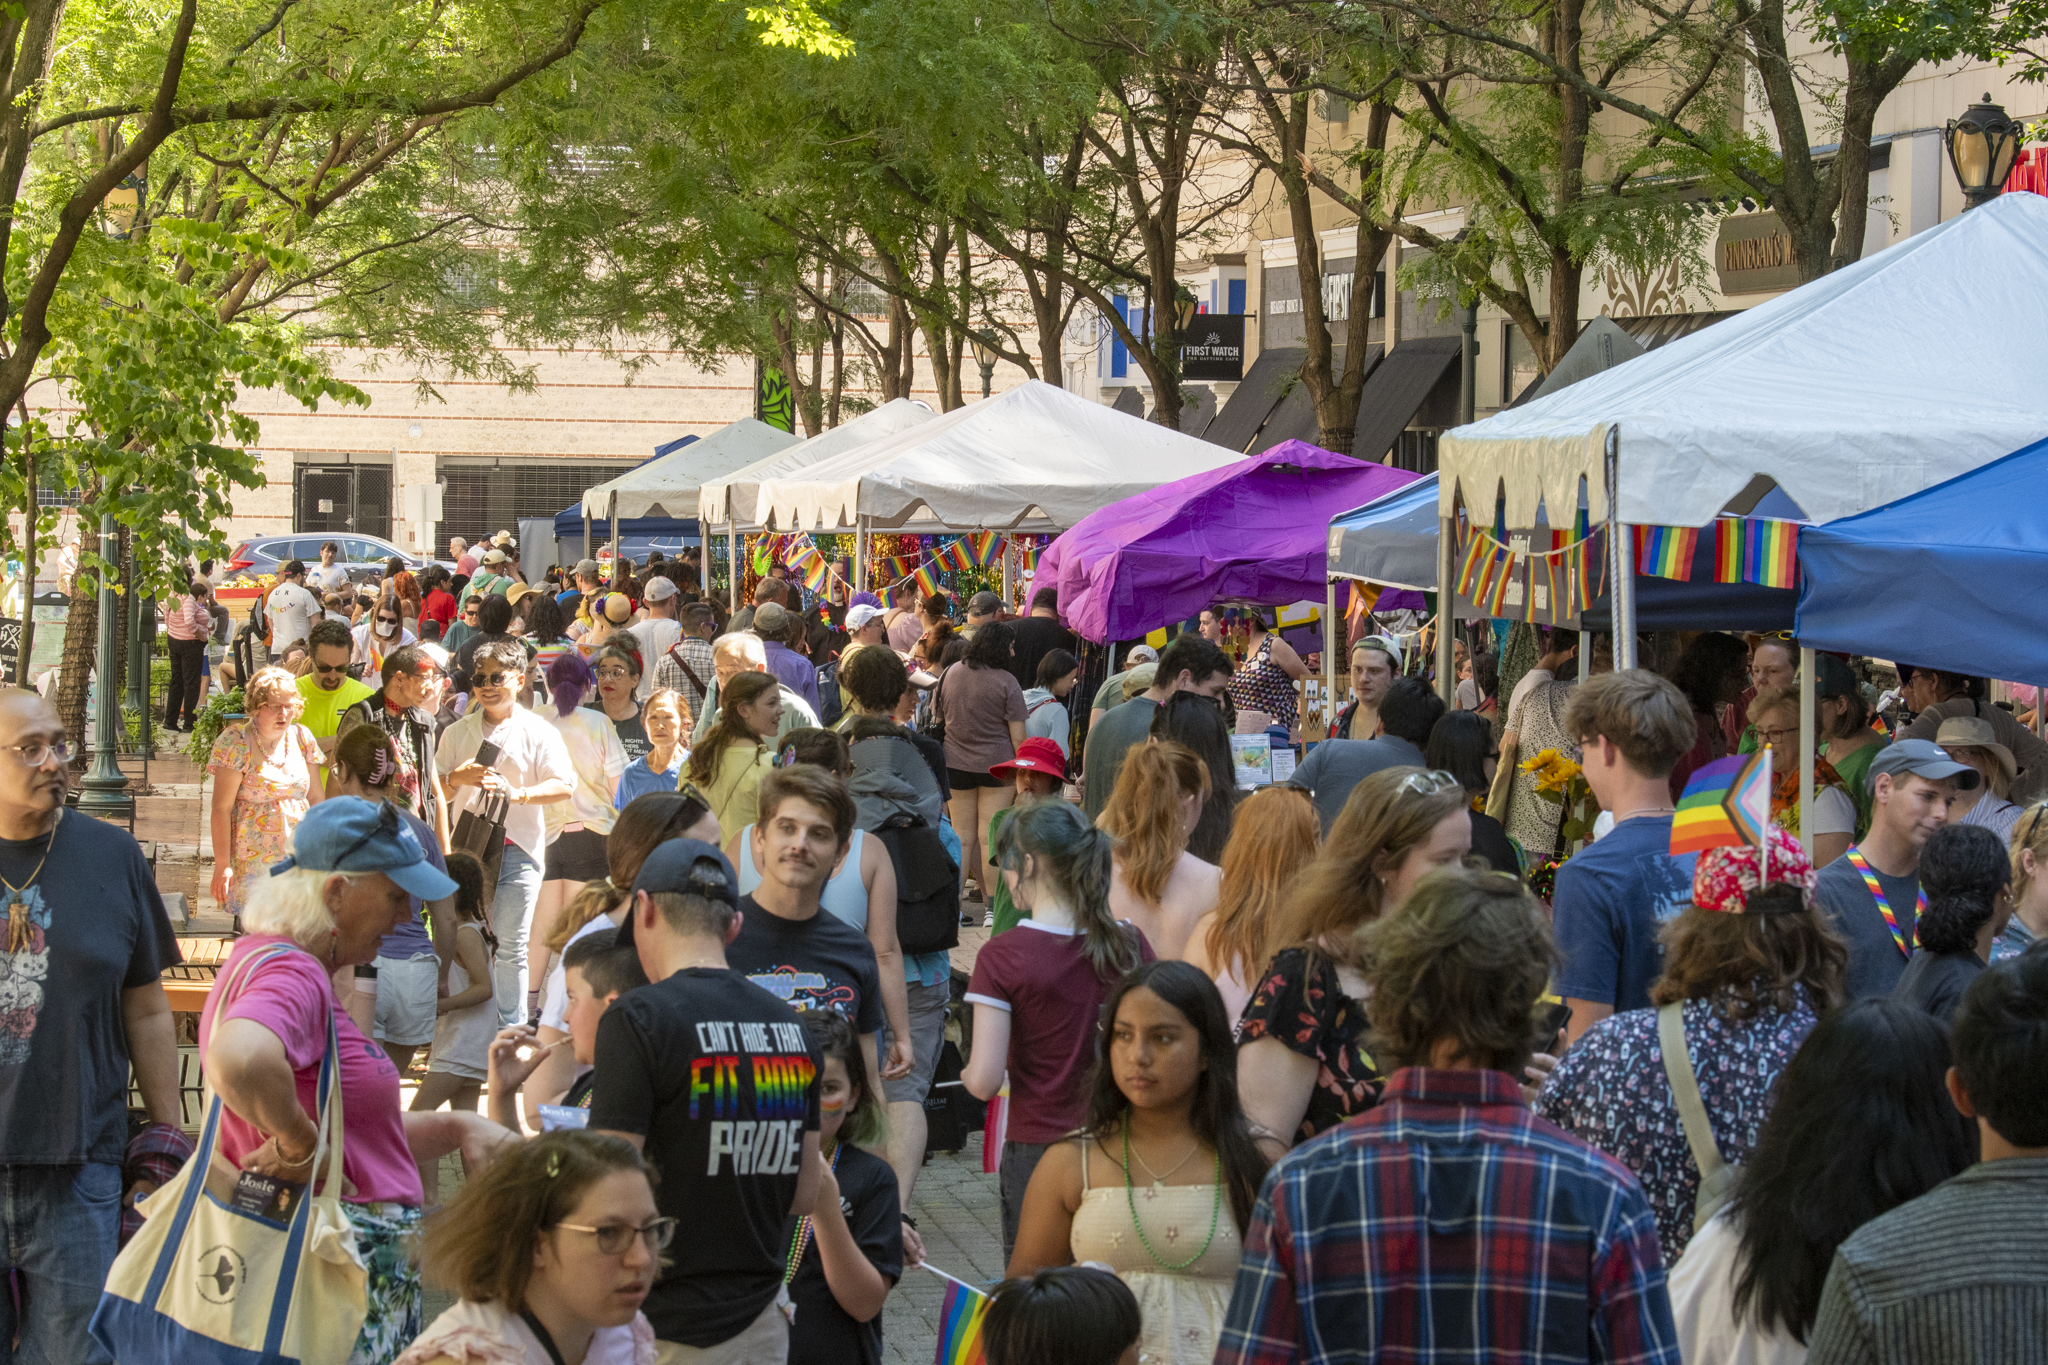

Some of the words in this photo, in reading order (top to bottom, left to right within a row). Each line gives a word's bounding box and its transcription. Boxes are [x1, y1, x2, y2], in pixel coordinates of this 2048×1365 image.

[1724, 228, 1781, 271] FINNEGAN'S
[1186, 346, 1210, 356] FIRST
[1211, 346, 1239, 356] WATCH
[695, 1021, 738, 1053] CAN'T
[738, 1022, 774, 1053] HIDE
[769, 1022, 808, 1053] THAT
[689, 1056, 740, 1120] FIT
[707, 1119, 803, 1176] PRIDE
[239, 1174, 275, 1193] Josie
